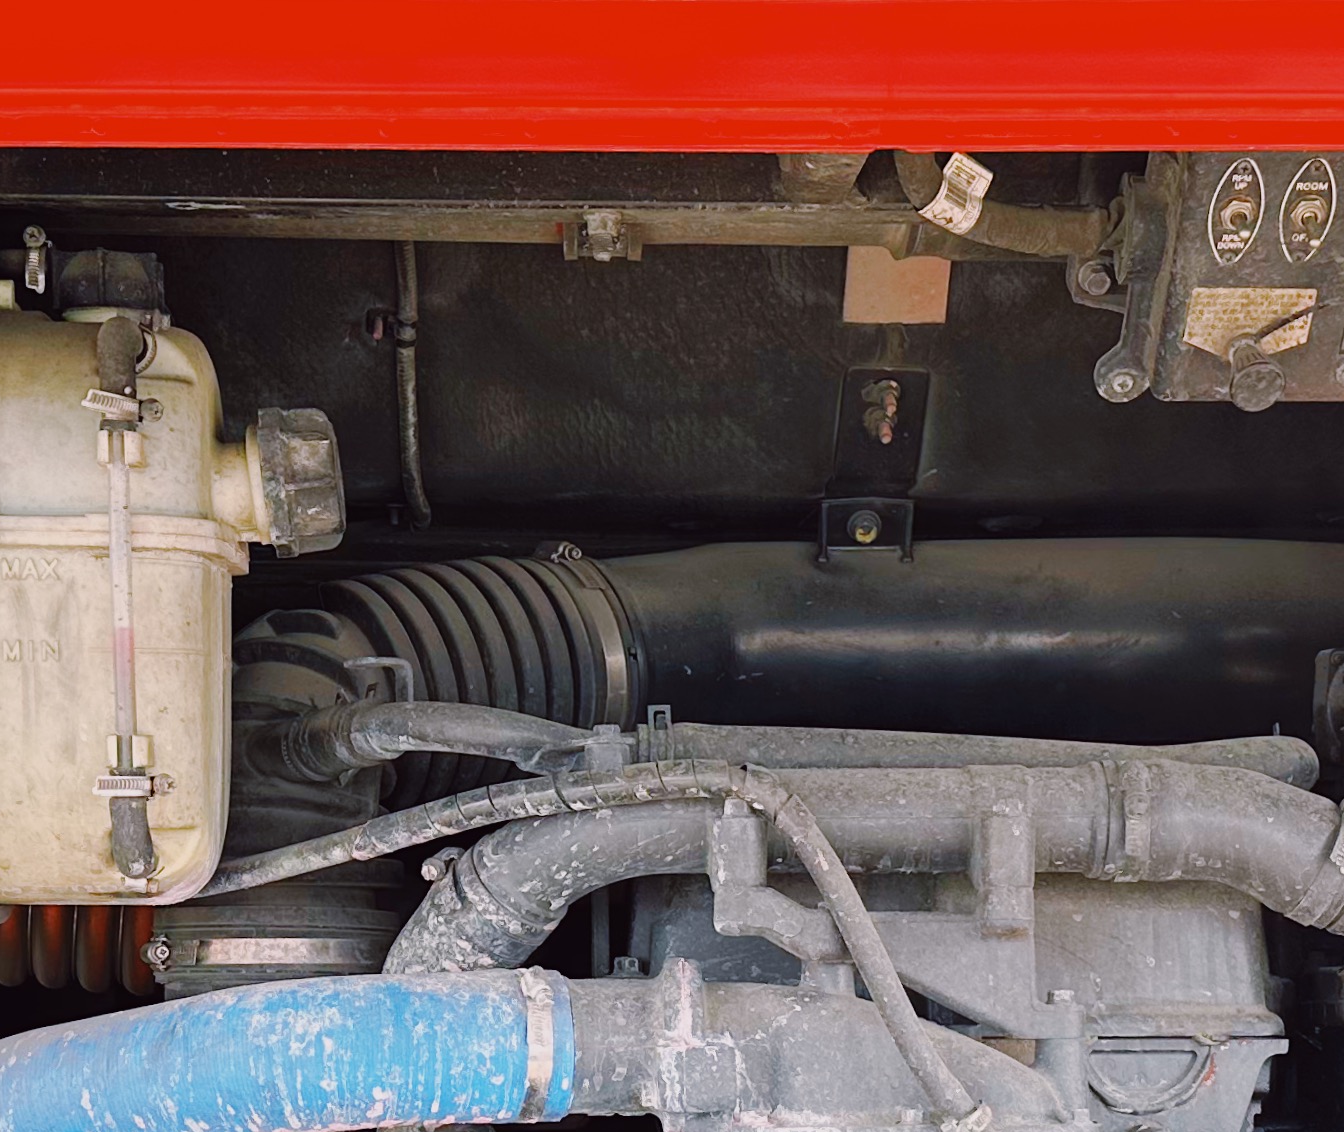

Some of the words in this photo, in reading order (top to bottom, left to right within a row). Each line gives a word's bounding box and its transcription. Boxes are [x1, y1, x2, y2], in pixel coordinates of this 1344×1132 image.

[1296, 182, 1329, 191] ROOM
[1217, 241, 1245, 250] DOWN
[0, 557, 60, 580] MAX
[2, 639, 60, 662] MIN
